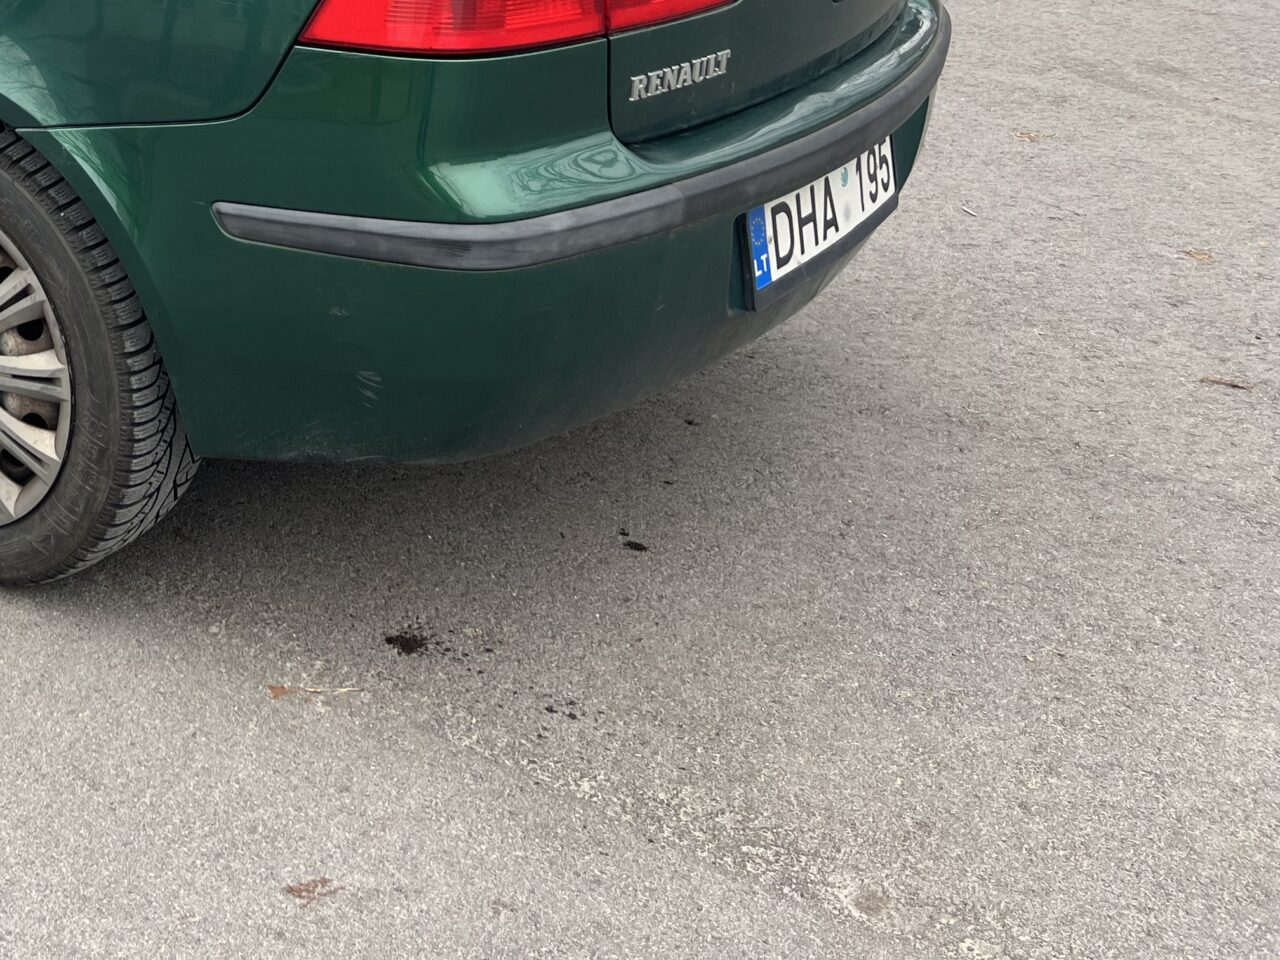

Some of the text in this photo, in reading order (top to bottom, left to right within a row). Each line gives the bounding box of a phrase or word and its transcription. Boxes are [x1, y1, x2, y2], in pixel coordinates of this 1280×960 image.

[628, 49, 732, 102] RENAULT
[770, 138, 891, 270] DHA 195
[753, 253, 768, 278] LT
